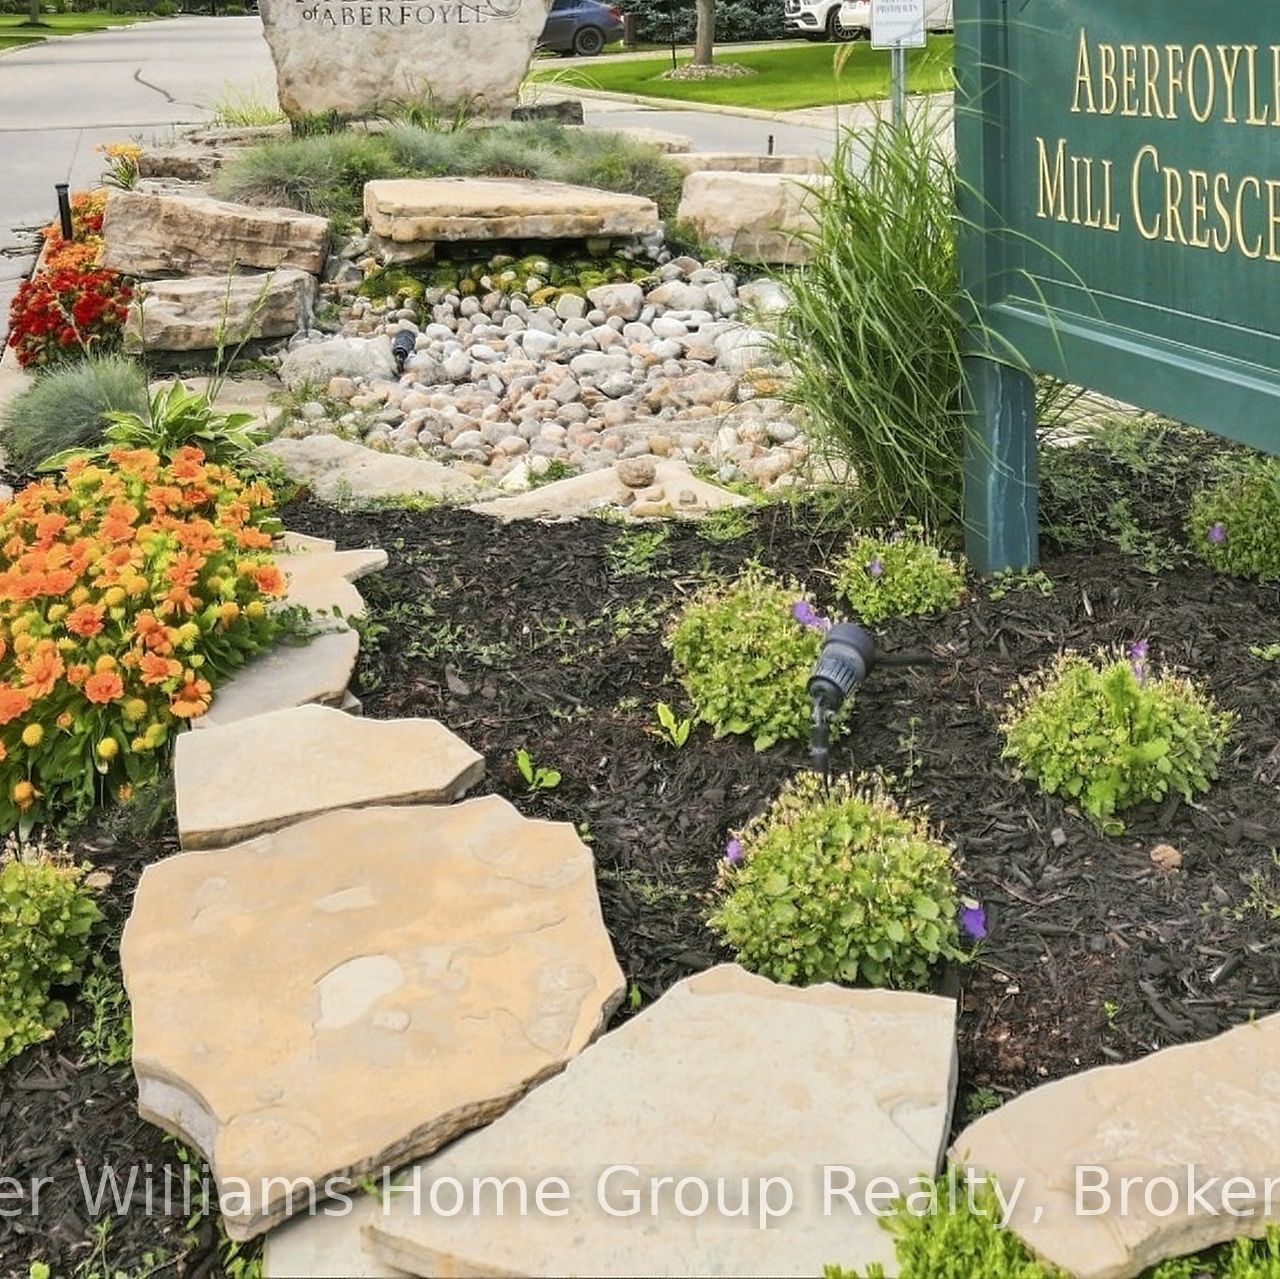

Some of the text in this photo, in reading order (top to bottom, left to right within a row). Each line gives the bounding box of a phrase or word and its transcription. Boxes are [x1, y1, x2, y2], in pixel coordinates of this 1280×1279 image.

[302, 4, 488, 26] of ABERFOYLE
[1035, 136, 1120, 232] MILL
